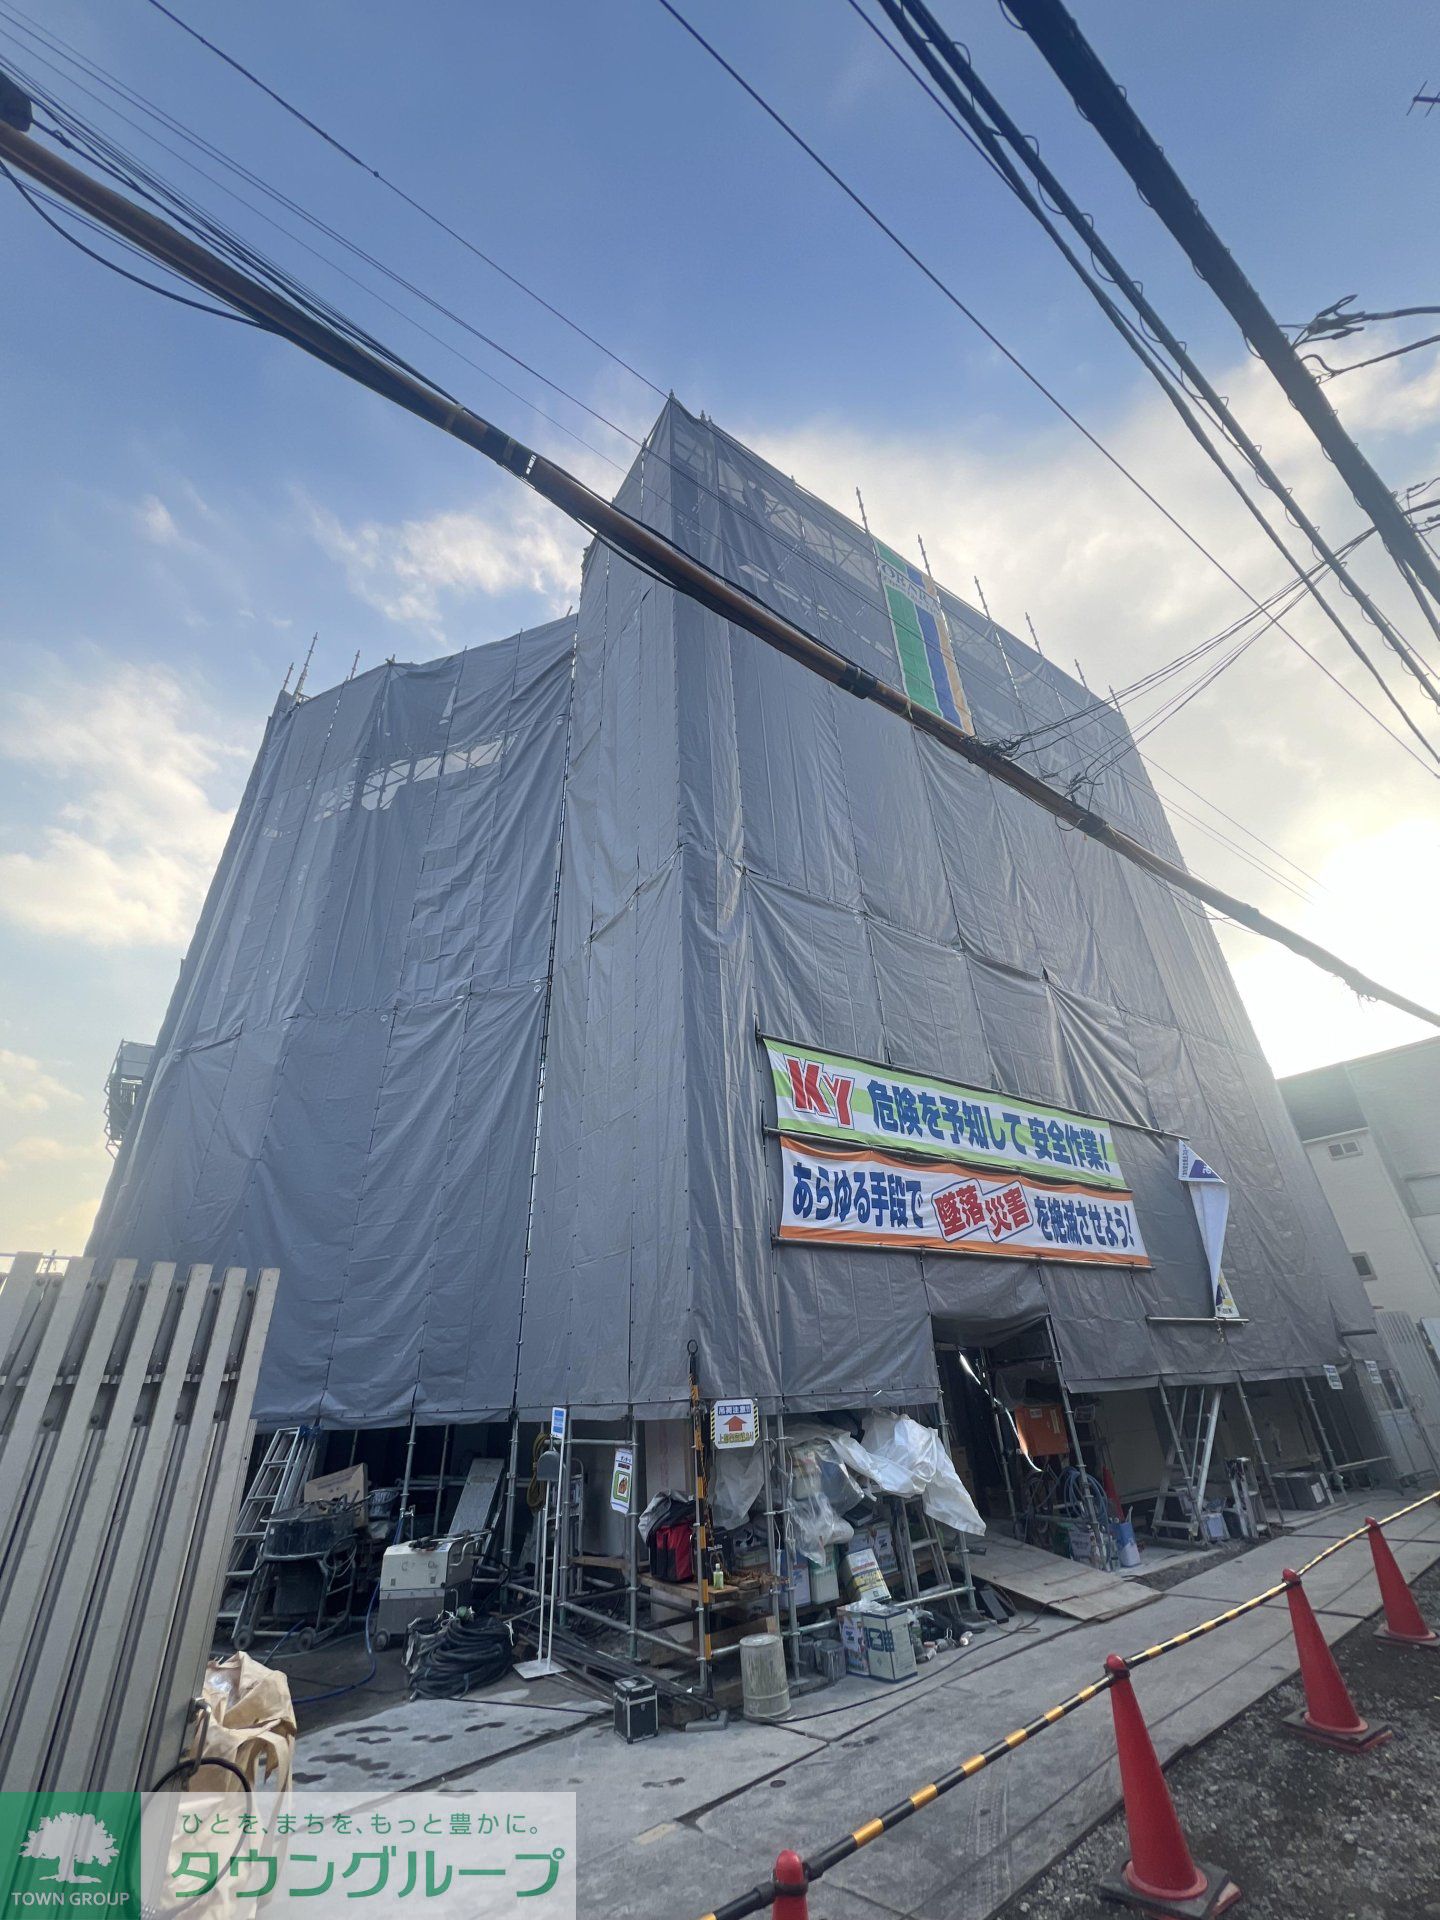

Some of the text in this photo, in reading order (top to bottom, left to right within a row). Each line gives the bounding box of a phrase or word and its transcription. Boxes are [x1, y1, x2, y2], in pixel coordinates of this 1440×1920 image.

[784, 1055, 854, 1129] KY
[792, 1161, 924, 1228] あらゆる手段で
